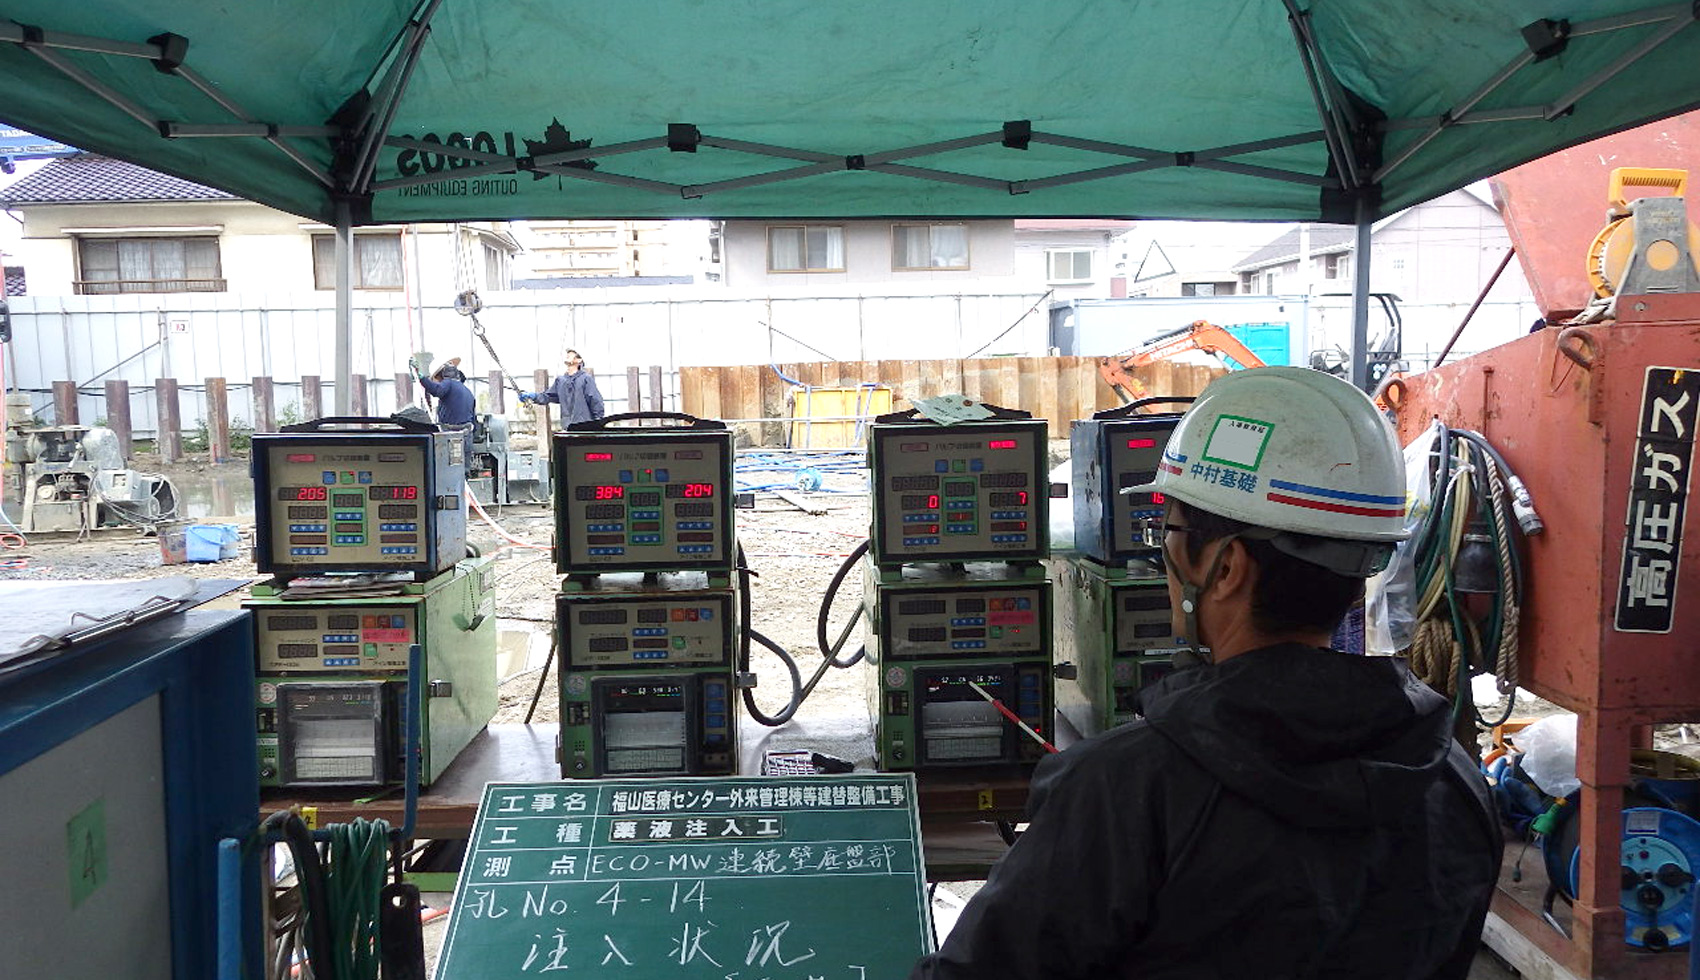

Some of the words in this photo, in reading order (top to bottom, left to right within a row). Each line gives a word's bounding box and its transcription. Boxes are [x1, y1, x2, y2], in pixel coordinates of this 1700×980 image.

[1190, 462, 1259, 493] 中村基礎
[297, 487, 327, 501] 205
[595, 486, 624, 500] 384
[684, 484, 714, 498] 204
[928, 495, 939, 509] 0
[1018, 491, 1028, 505] 7
[1626, 391, 1690, 608] 高圧ガス
[498, 792, 587, 813] 工事名
[612, 785, 905, 813] 福山医療センター外来管理棟等建替整備工事
[490, 822, 584, 845] 工種
[613, 818, 779, 839] 薬液注入工
[483, 854, 578, 878] 測点
[591, 853, 712, 874] ECO-MW
[520, 919, 817, 973] 注入状況
